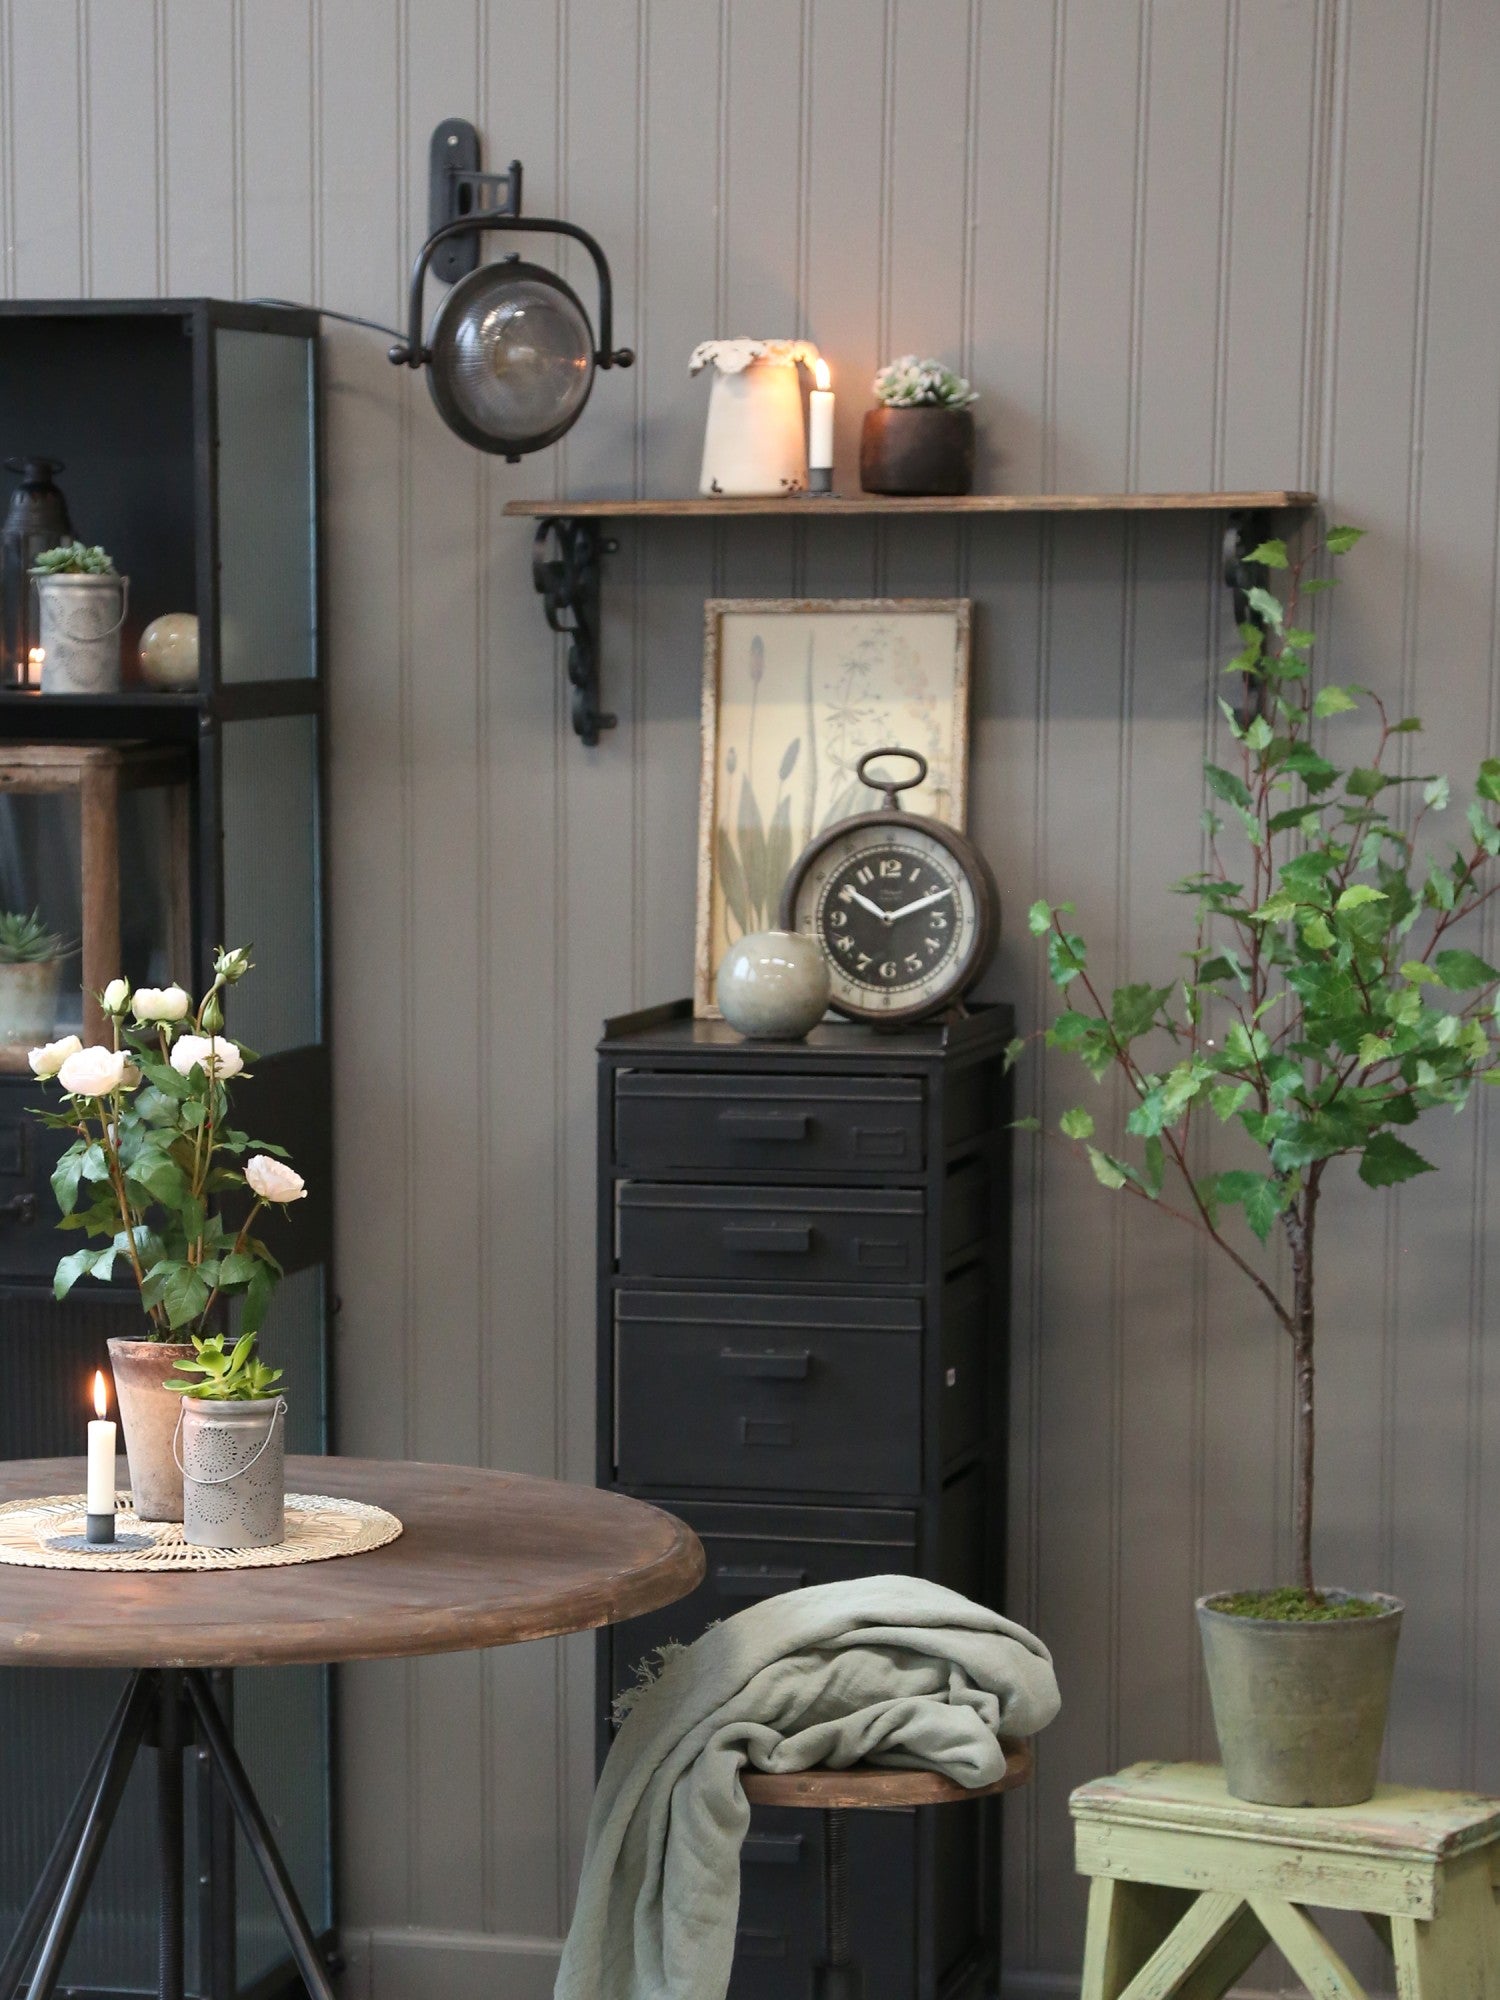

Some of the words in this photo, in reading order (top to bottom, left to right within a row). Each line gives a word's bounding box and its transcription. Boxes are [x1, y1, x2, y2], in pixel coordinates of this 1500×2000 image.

[879, 859, 902, 878] 12
[830, 910, 848, 928] 9
[856, 952, 873, 971] 7
[879, 961, 898, 979] 6
[904, 952, 923, 973] 5
